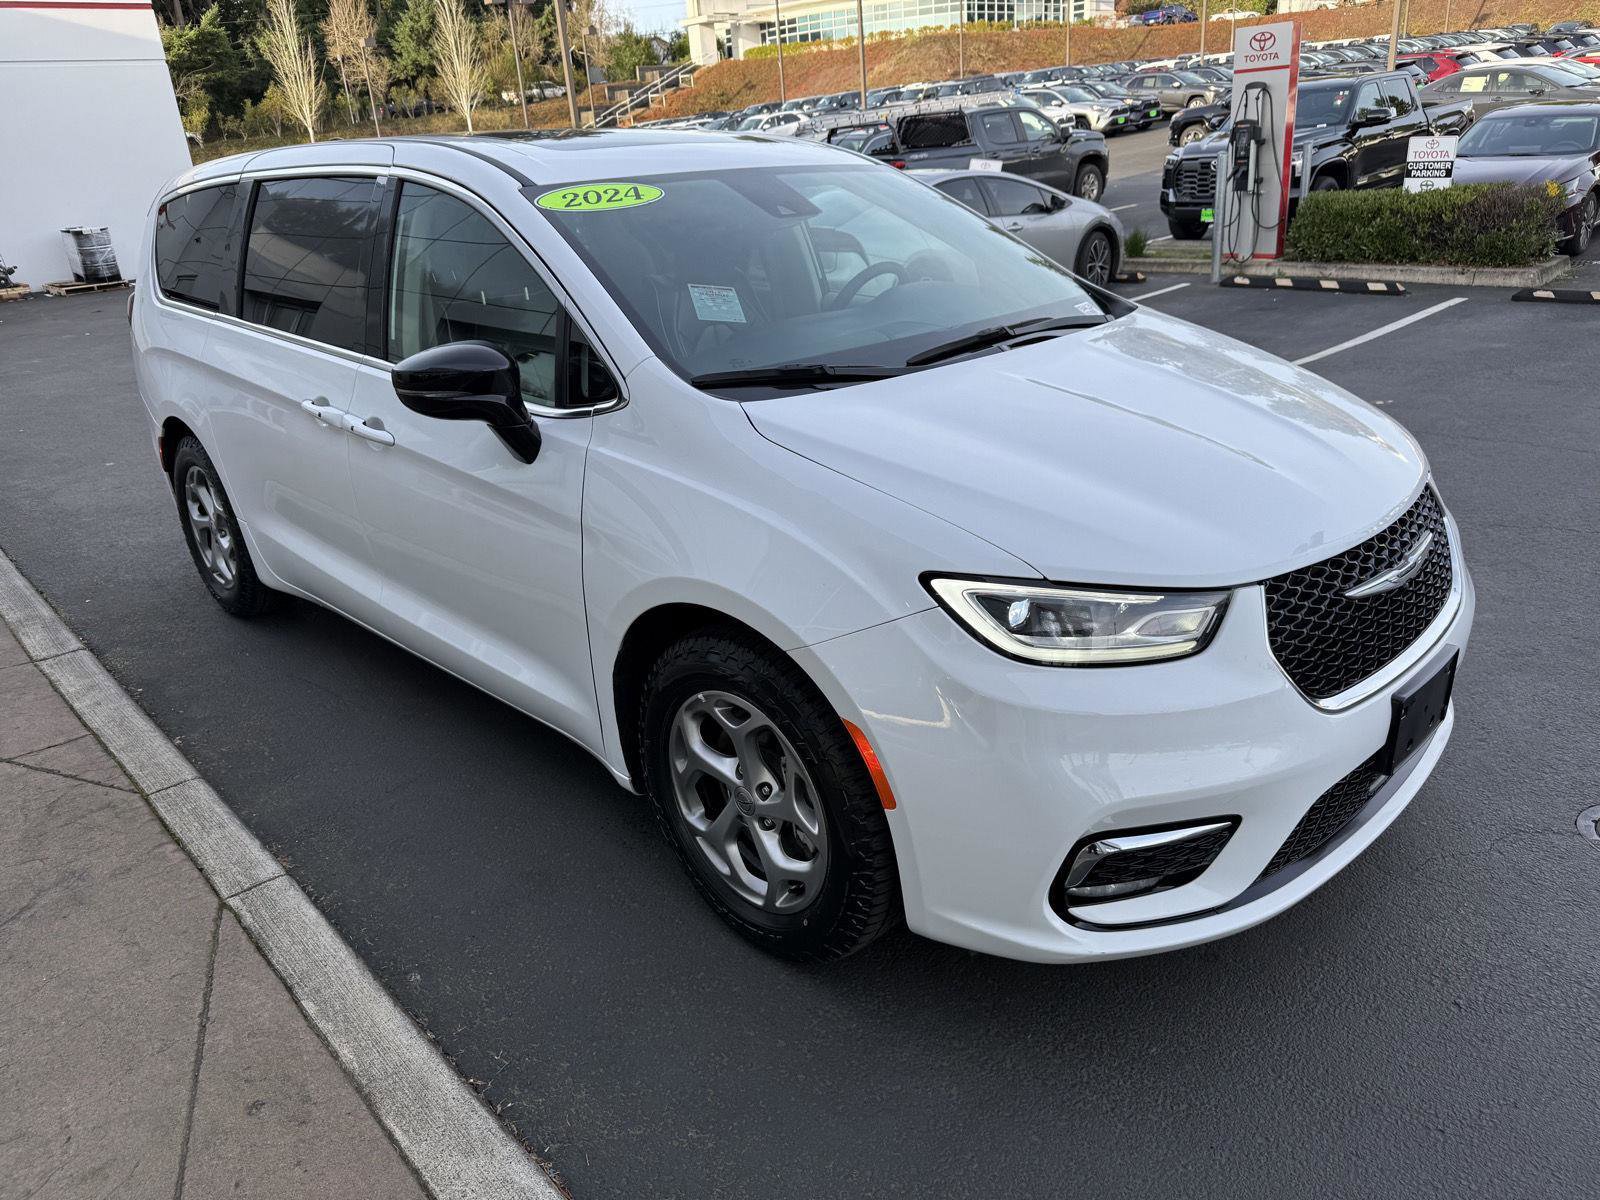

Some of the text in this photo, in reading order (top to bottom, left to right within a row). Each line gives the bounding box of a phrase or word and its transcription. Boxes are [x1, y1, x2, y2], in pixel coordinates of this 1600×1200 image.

[1244, 52, 1279, 62] TOYOTA
[1412, 150, 1449, 159] TOYOTA
[1408, 162, 1451, 170] CUSTOMER
[1411, 169, 1446, 177] PARKING
[562, 186, 644, 208] 2024
